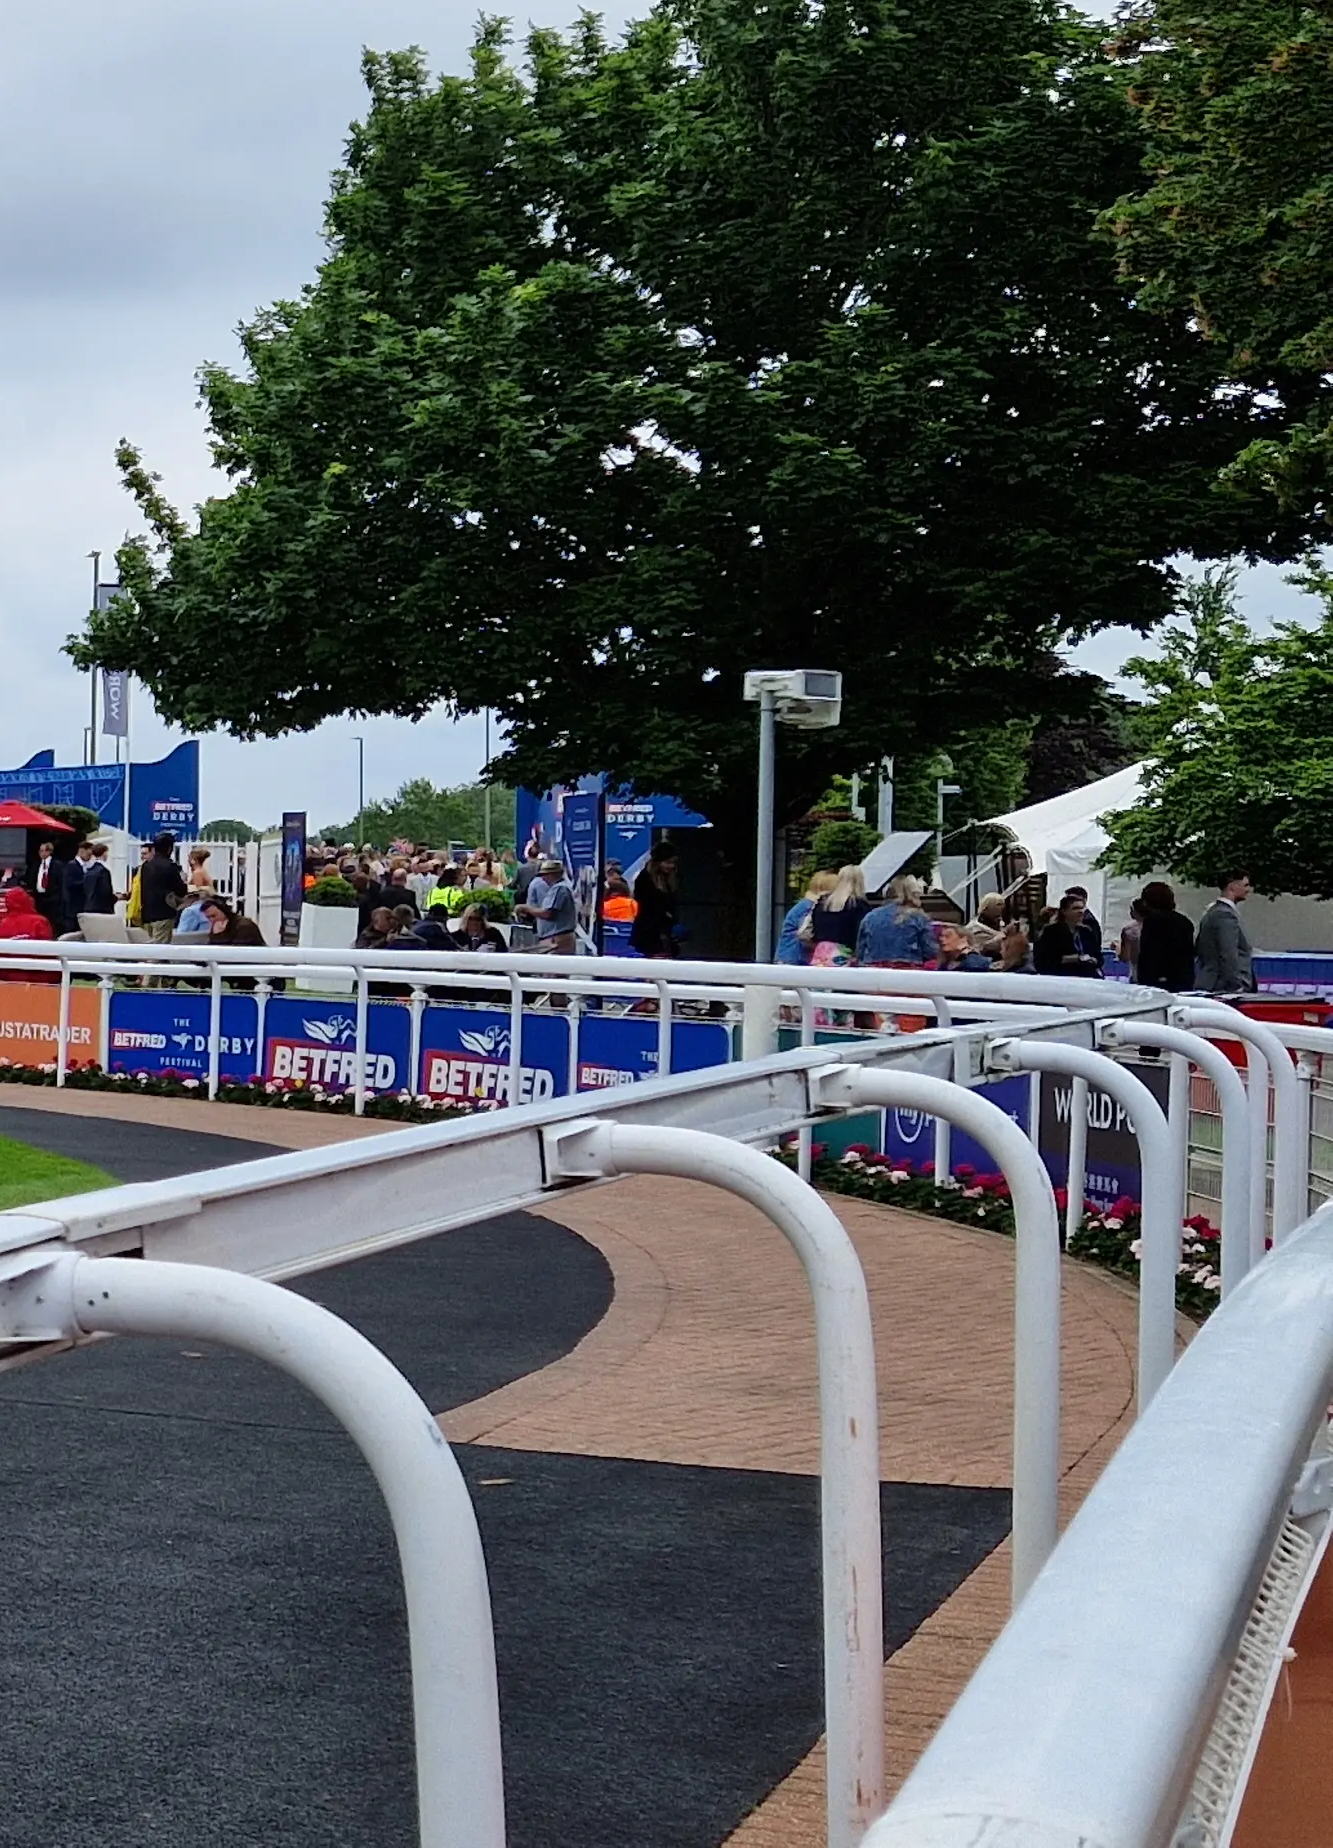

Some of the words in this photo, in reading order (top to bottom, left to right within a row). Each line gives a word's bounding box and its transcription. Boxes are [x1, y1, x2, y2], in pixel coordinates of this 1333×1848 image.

[173, 1017, 190, 1027] THE
[113, 1032, 167, 1049] BETFRED
[194, 1035, 255, 1056] DRBY
[160, 1056, 203, 1068] FESTIVAL
[272, 1045, 396, 1089] BETFRED
[429, 1057, 554, 1104] BETFRED
[582, 1067, 634, 1087] BETFRED
[1054, 1086, 1112, 1130] WRLD
